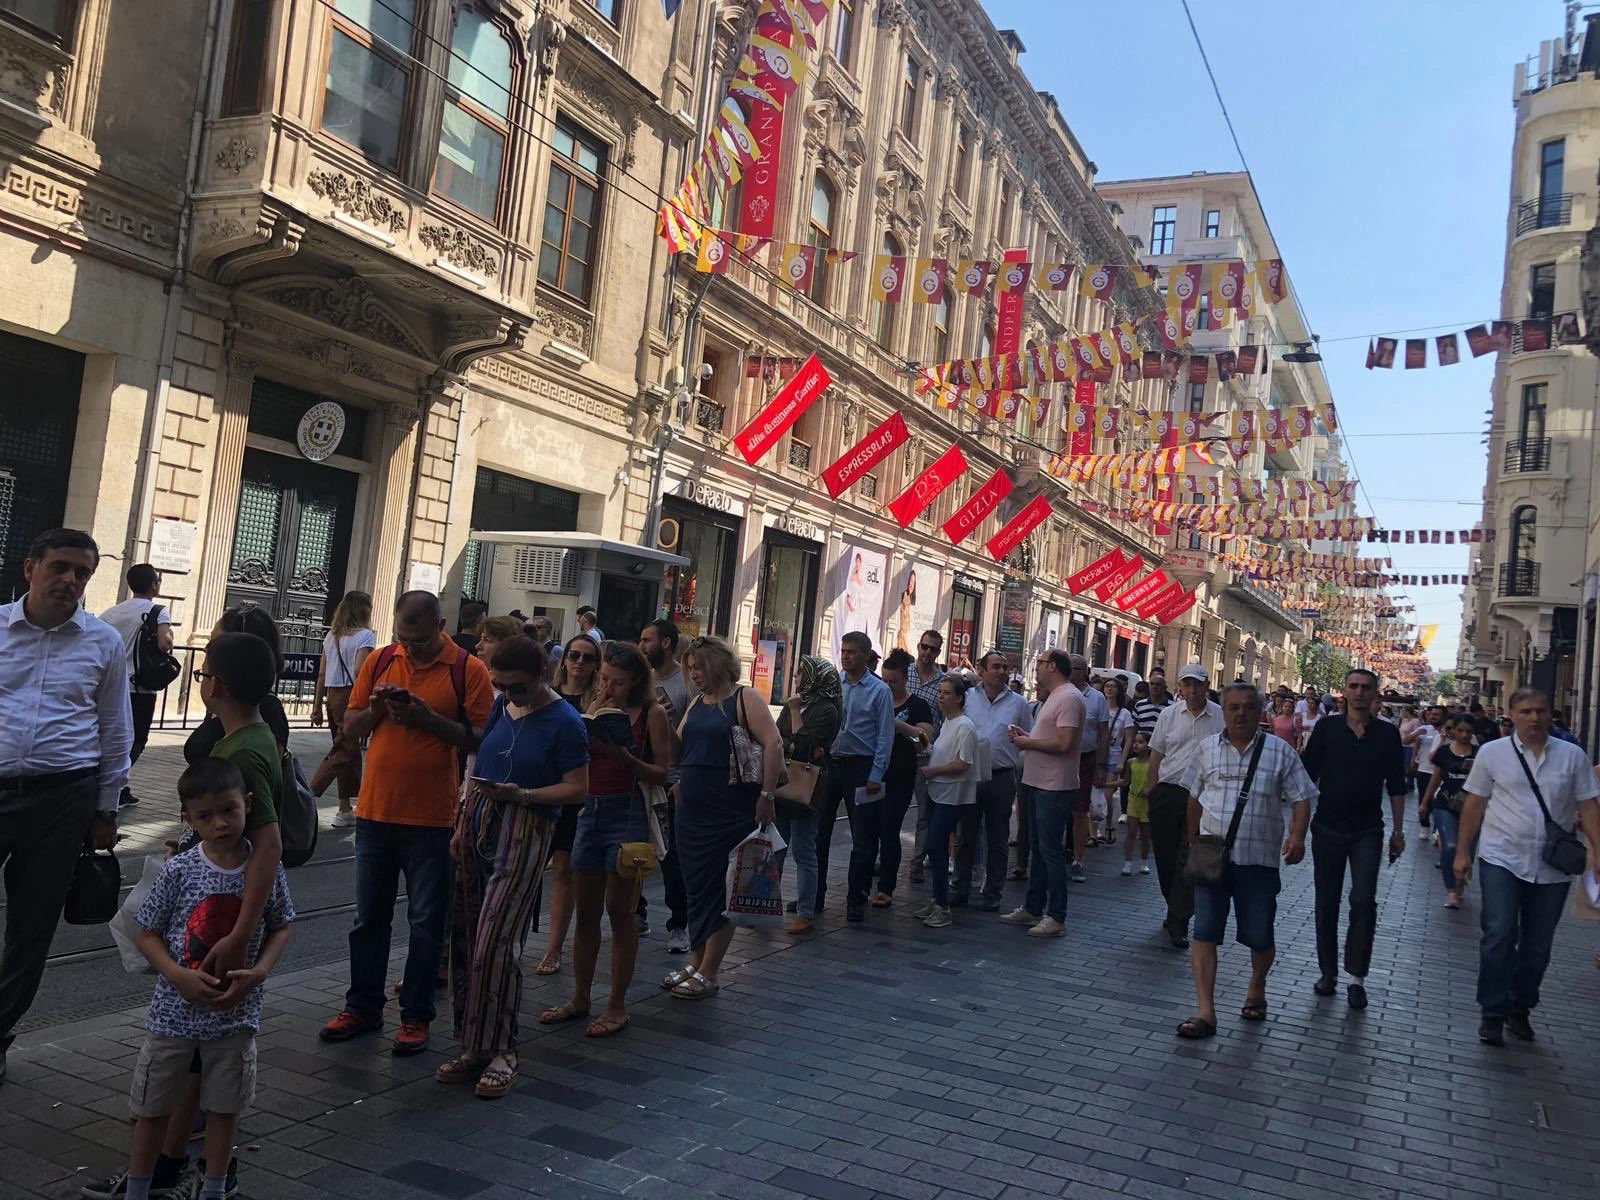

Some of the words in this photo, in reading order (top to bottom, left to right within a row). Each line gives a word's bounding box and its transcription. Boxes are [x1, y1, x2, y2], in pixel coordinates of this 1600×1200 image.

[764, 400, 797, 434] Business
[685, 479, 733, 513] DeFacto
[959, 490, 998, 528] GIZIA
[780, 513, 818, 539] DeFacto
[1079, 560, 1113, 586] DeFacto
[953, 632, 971, 647] 50
[283, 657, 315, 673] POLİS
